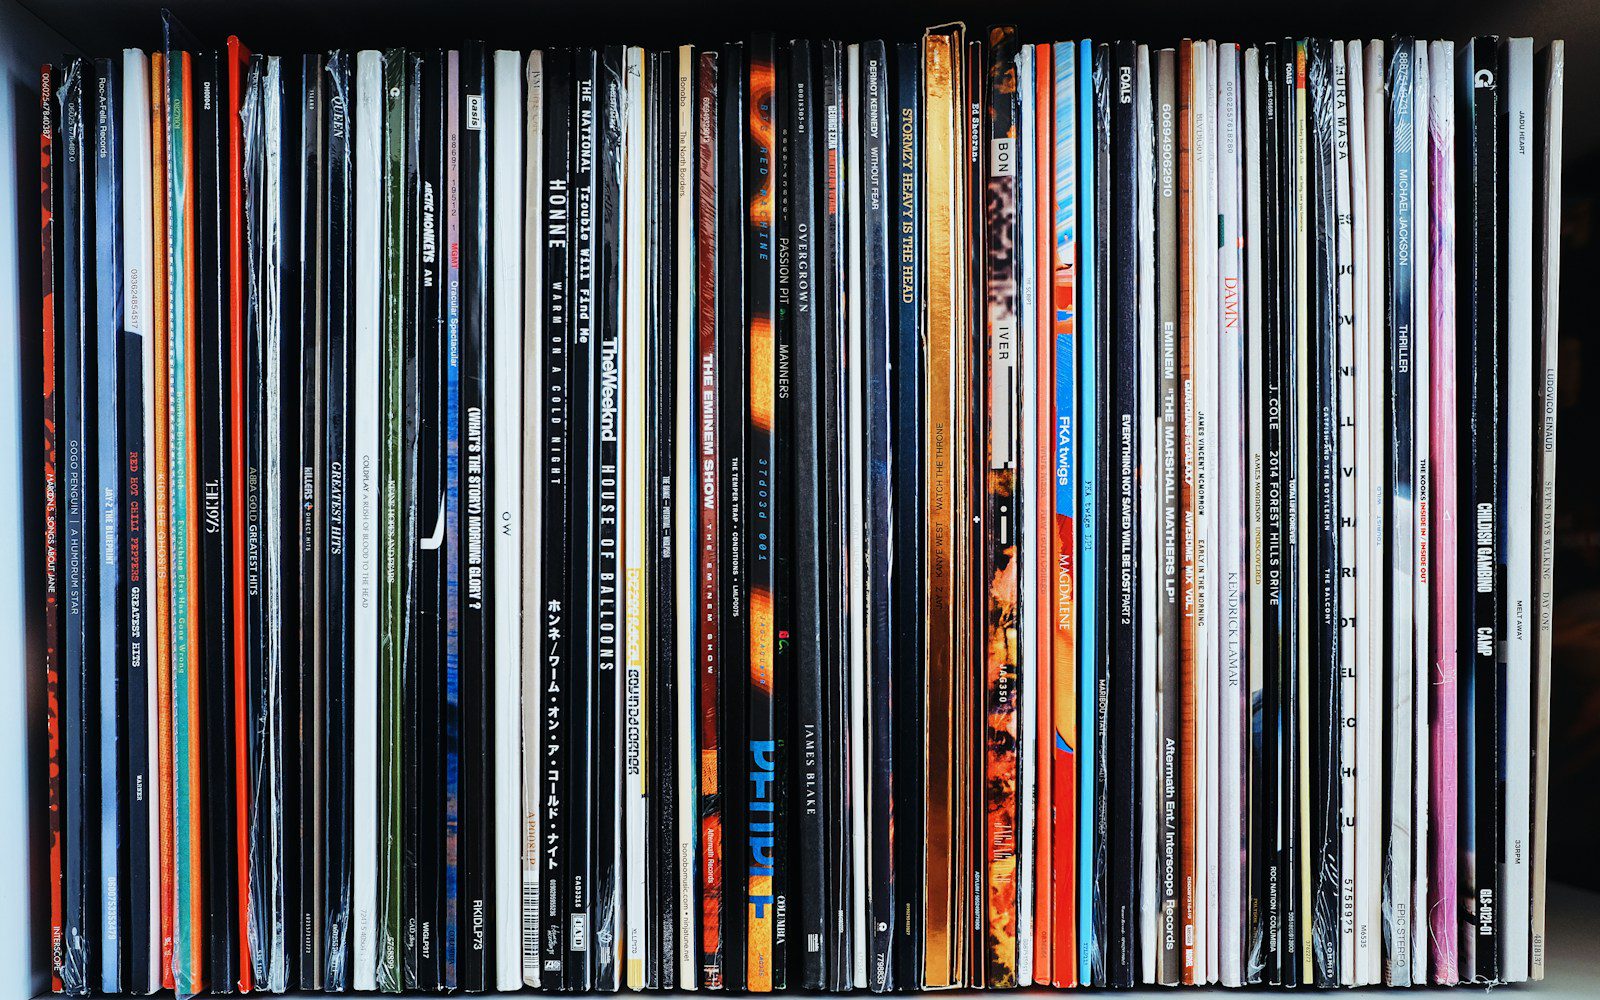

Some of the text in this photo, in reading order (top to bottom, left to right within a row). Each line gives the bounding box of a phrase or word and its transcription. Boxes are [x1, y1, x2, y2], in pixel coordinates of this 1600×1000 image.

[42, 73, 51, 139] 00602547840387
[1120, 67, 1130, 104] FOALS
[98, 78, 108, 158] Roc-A-Fella Records
[332, 96, 343, 138] QUEEN
[471, 99, 479, 126] oasis
[869, 60, 879, 210] DERMOT KENNEDY WITHOUT FEAR
[1226, 82, 1234, 154] 00602557618280
[1162, 104, 1172, 197] 606949062910
[549, 180, 566, 248] HONNE
[579, 79, 591, 343] THE NATIONAL Trouble Will Find Me
[902, 108, 913, 303] STORMZY HEAVY IS THE HEAD
[423, 181, 435, 286] ARCTIC MONKEYS AM
[998, 142, 1008, 360] BON IVER
[1399, 169, 1408, 373] MICHAEL JACKSON THRILLER
[450, 281, 458, 316] Oracular
[552, 282, 562, 323] WARM
[779, 238, 789, 399] PASSION PIT MANNERS
[1224, 277, 1238, 334] DAMN.
[449, 318, 458, 367] Spectacular
[552, 337, 561, 354] ON
[703, 353, 713, 386] THE
[551, 386, 560, 424] COLD
[704, 390, 713, 455] EMINEM
[70, 440, 78, 469] GOGO
[130, 452, 138, 472] RED
[551, 437, 560, 484] NIGHT
[1121, 414, 1131, 475] EVERYTHING
[70, 473, 78, 514] PENGUIN
[704, 459, 714, 509] SHOW
[1121, 476, 1130, 496] NOT
[1268, 384, 1279, 605] J. COLE 2014 FOREST HILLS DRIVE
[1541, 369, 1554, 631] LUDOVICO EINAUDI SEVEN DAYS WALKING DAY ONE
[105, 487, 114, 565] JAY-Z THE BLUEPRINT
[157, 474, 166, 578] KIDS SEE GHOSTS
[331, 461, 342, 555] GREATEST HITS
[363, 522, 369, 531] OF
[1057, 416, 1070, 630] FKA twigs MAGDALENE
[1122, 497, 1130, 529] SAVED
[131, 538, 139, 582] PEPPERS
[250, 525, 258, 572] GREATEST
[1122, 530, 1130, 553] WILL
[1122, 554, 1130, 567] BE
[250, 575, 258, 596] HITS
[362, 561, 369, 570] TO
[1122, 568, 1131, 593] LOST
[1198, 565, 1204, 573] IN
[1476, 503, 1493, 657] CHILDISH GAMBINO CAMP
[71, 591, 79, 614] STAR
[131, 587, 140, 637] GREATEST
[1122, 594, 1130, 616] PART
[1228, 572, 1238, 687] KENDRICK LAMAR
[132, 643, 140, 667] HITS
[999, 664, 1007, 702] JAG350
[707, 859, 715, 884] Records
[473, 900, 482, 950] RKIDLP73
[1397, 903, 1405, 967] EPIC STEREO
[1479, 889, 1492, 935] GLS-0121-01
[53, 926, 61, 971] INTERSCOPE
[682, 917, 690, 961] ninjatune.net
[1534, 934, 1542, 966] 4818137
